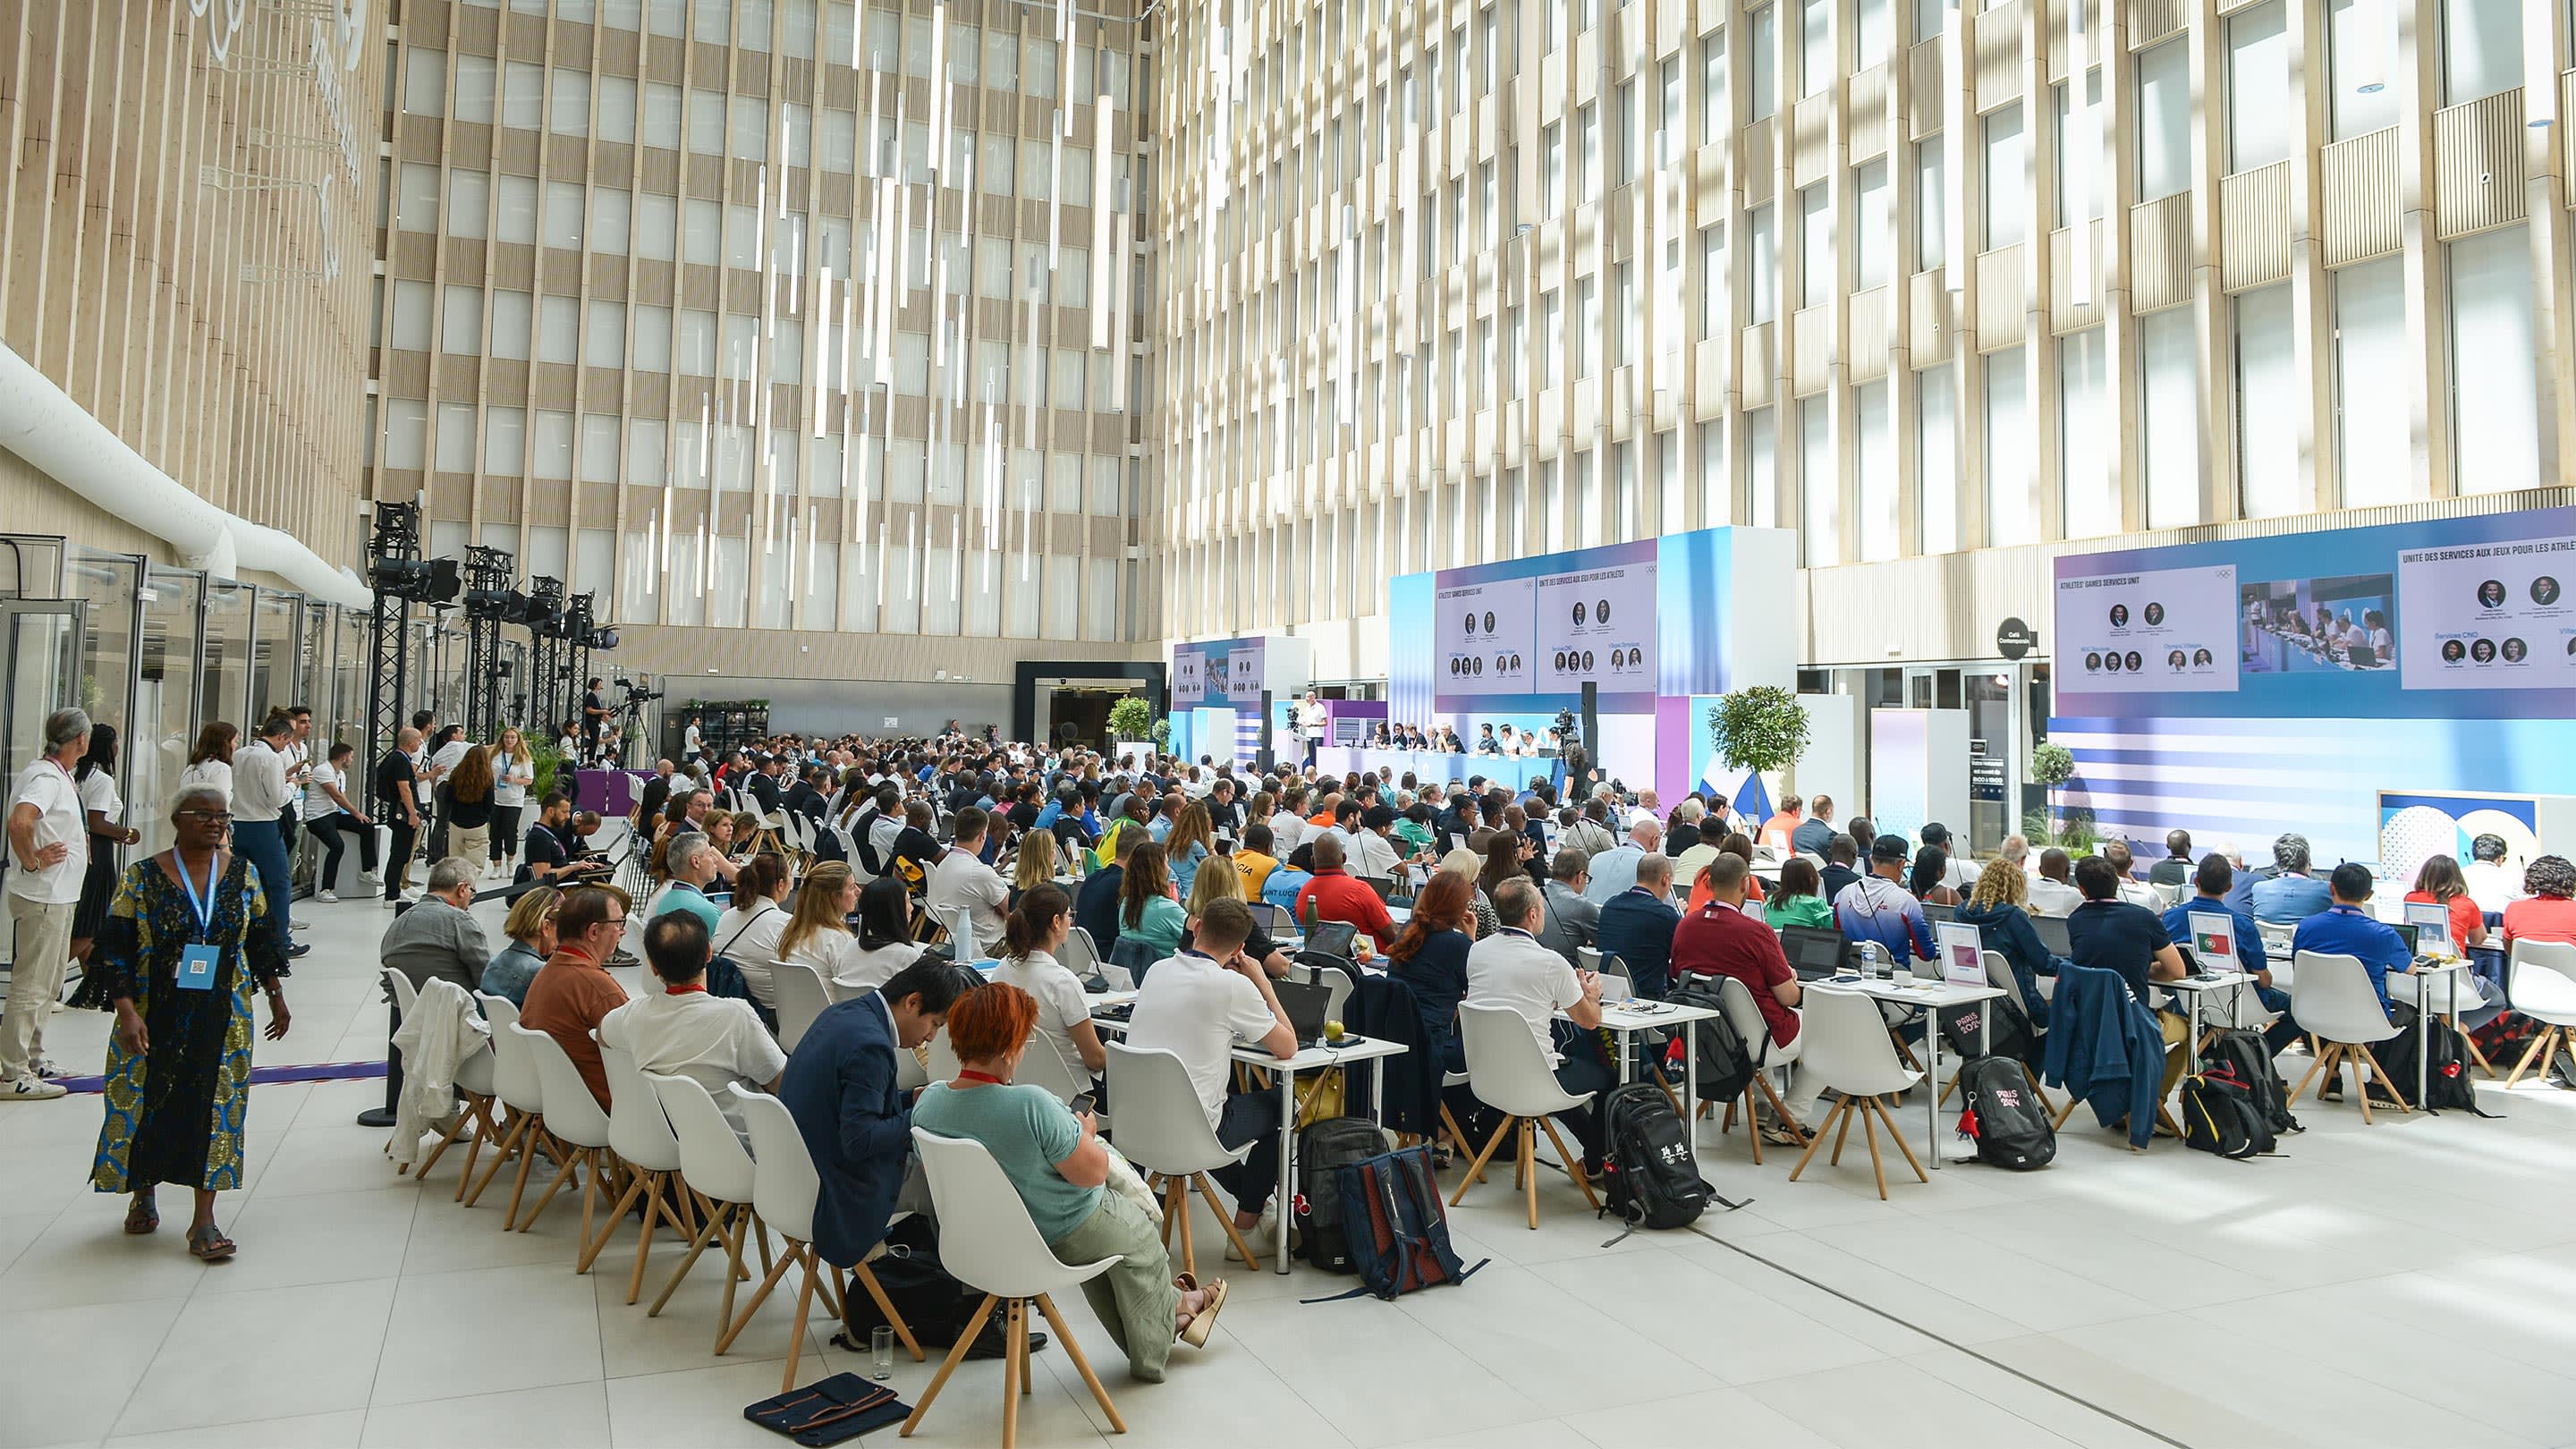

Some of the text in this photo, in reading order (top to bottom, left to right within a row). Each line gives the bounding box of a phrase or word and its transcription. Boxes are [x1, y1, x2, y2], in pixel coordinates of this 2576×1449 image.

[2424, 552, 2438, 562] DES
[2440, 549, 2475, 561] SERVICES
[2476, 547, 2491, 557] AUX
[2492, 546, 2511, 556] JEUX
[2512, 544, 2534, 555] POUR
[2535, 542, 2549, 553] LES
[1556, 576, 1572, 585] SERVICES
[2085, 579, 2102, 589] GAMES
[2103, 577, 2127, 587] SERVICES
[2128, 576, 2140, 585] UNIT
[1236, 862, 1253, 877] CIA
